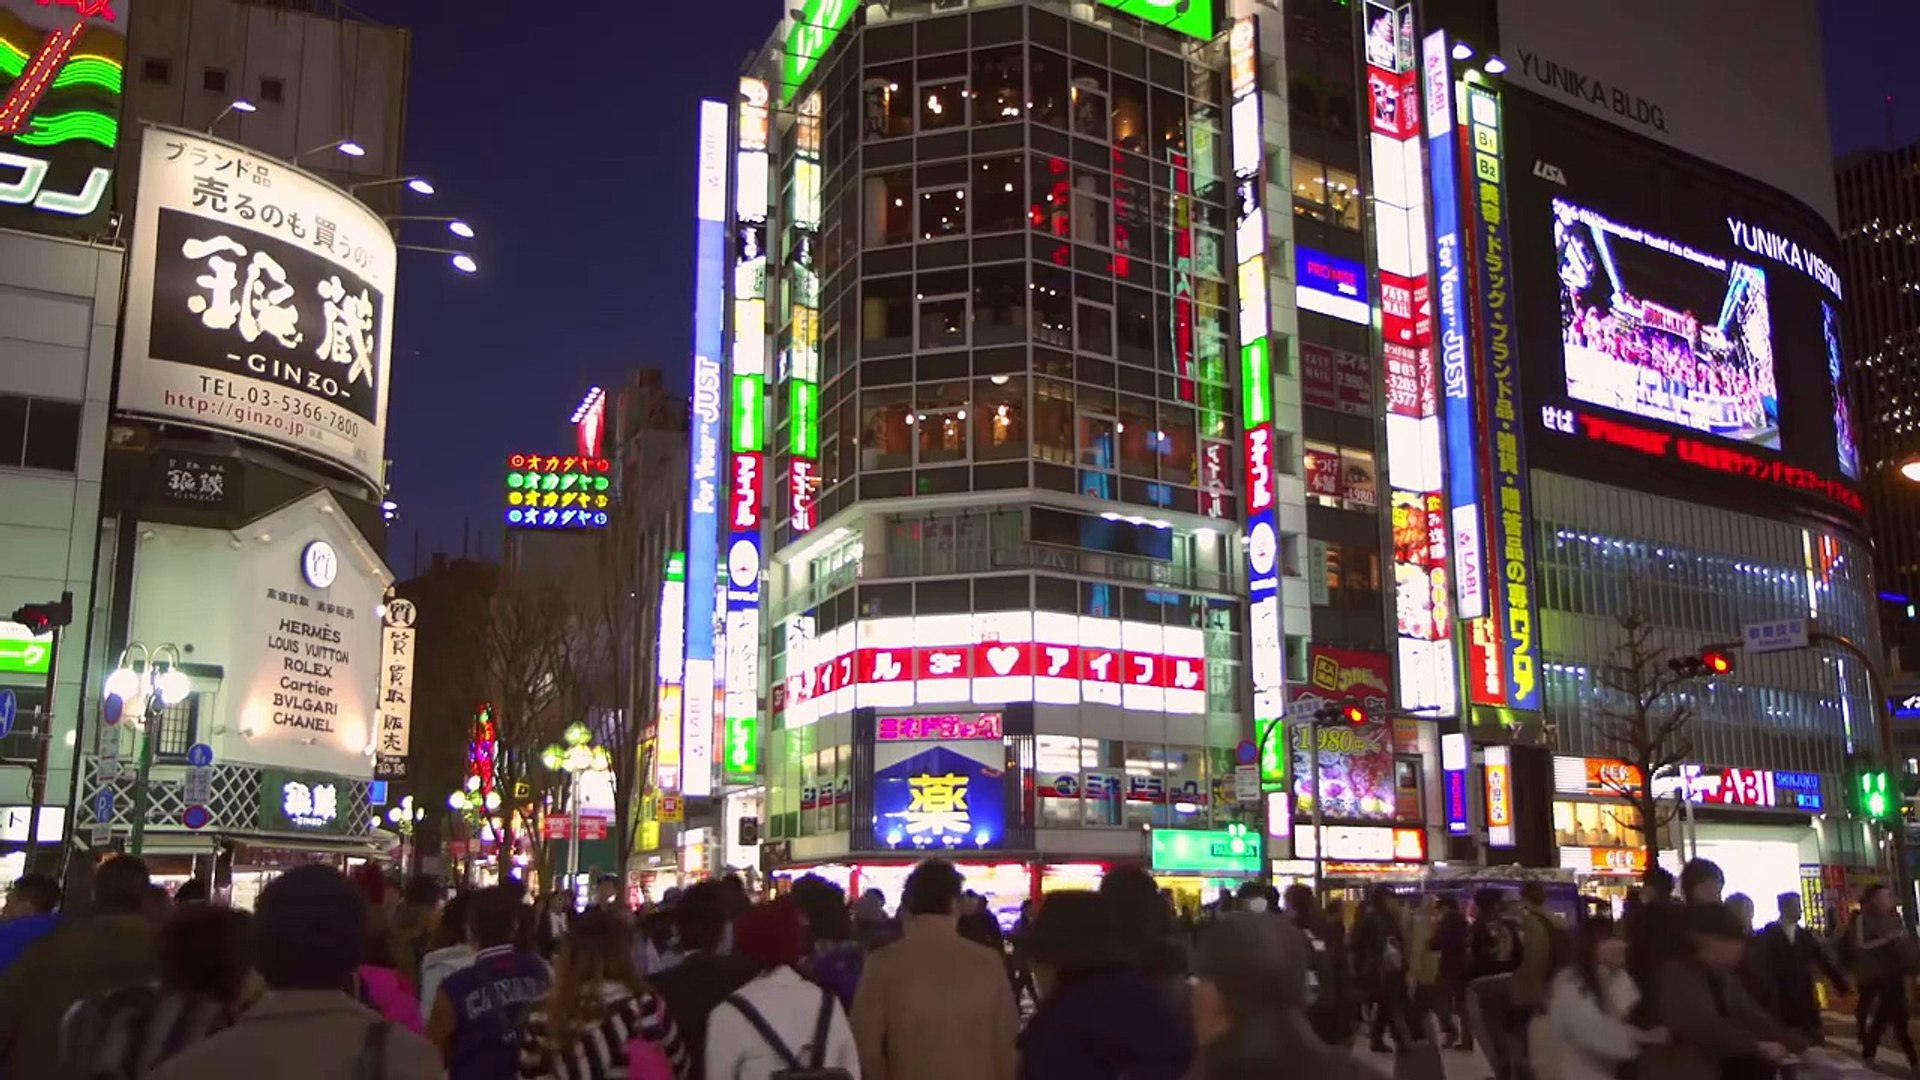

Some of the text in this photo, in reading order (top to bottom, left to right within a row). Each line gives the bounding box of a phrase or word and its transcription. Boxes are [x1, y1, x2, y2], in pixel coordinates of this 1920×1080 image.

[1434, 71, 1445, 111] LABI
[1517, 48, 1669, 134] YUNIKA BLDG.
[1479, 131, 1494, 148] B1
[164, 141, 272, 188] ブランド品
[1479, 157, 1497, 177] B2
[1438, 233, 1456, 268] For
[1727, 217, 1805, 270] YUNIKA
[1804, 249, 1842, 300] VISION
[1382, 284, 1410, 302] FAST
[1442, 330, 1468, 399] JUST
[694, 356, 721, 424] JUST
[164, 390, 306, 436] http://ginzo.jp
[524, 454, 594, 474] オカダヤ
[1250, 429, 1271, 508] アイフル
[524, 490, 594, 508] オカダヤ
[737, 456, 756, 526] アイフル
[524, 507, 594, 526] オカダヤ
[1464, 551, 1477, 595] LABI
[267, 588, 309, 607] 高価買取
[279, 618, 341, 644] HERMÈS
[268, 635, 349, 665] LOUIS VUITTON
[284, 657, 332, 678] ROLEX
[929, 653, 961, 674] 3F
[1045, 648, 1199, 688] アイフル
[280, 676, 333, 697] Cartier
[273, 692, 337, 714] BVLGARI
[273, 712, 334, 733] CHANEL
[880, 713, 1000, 738] ミネドラッグ
[1775, 773, 1818, 789] SHINJUKU
[906, 772, 972, 835] 薬
